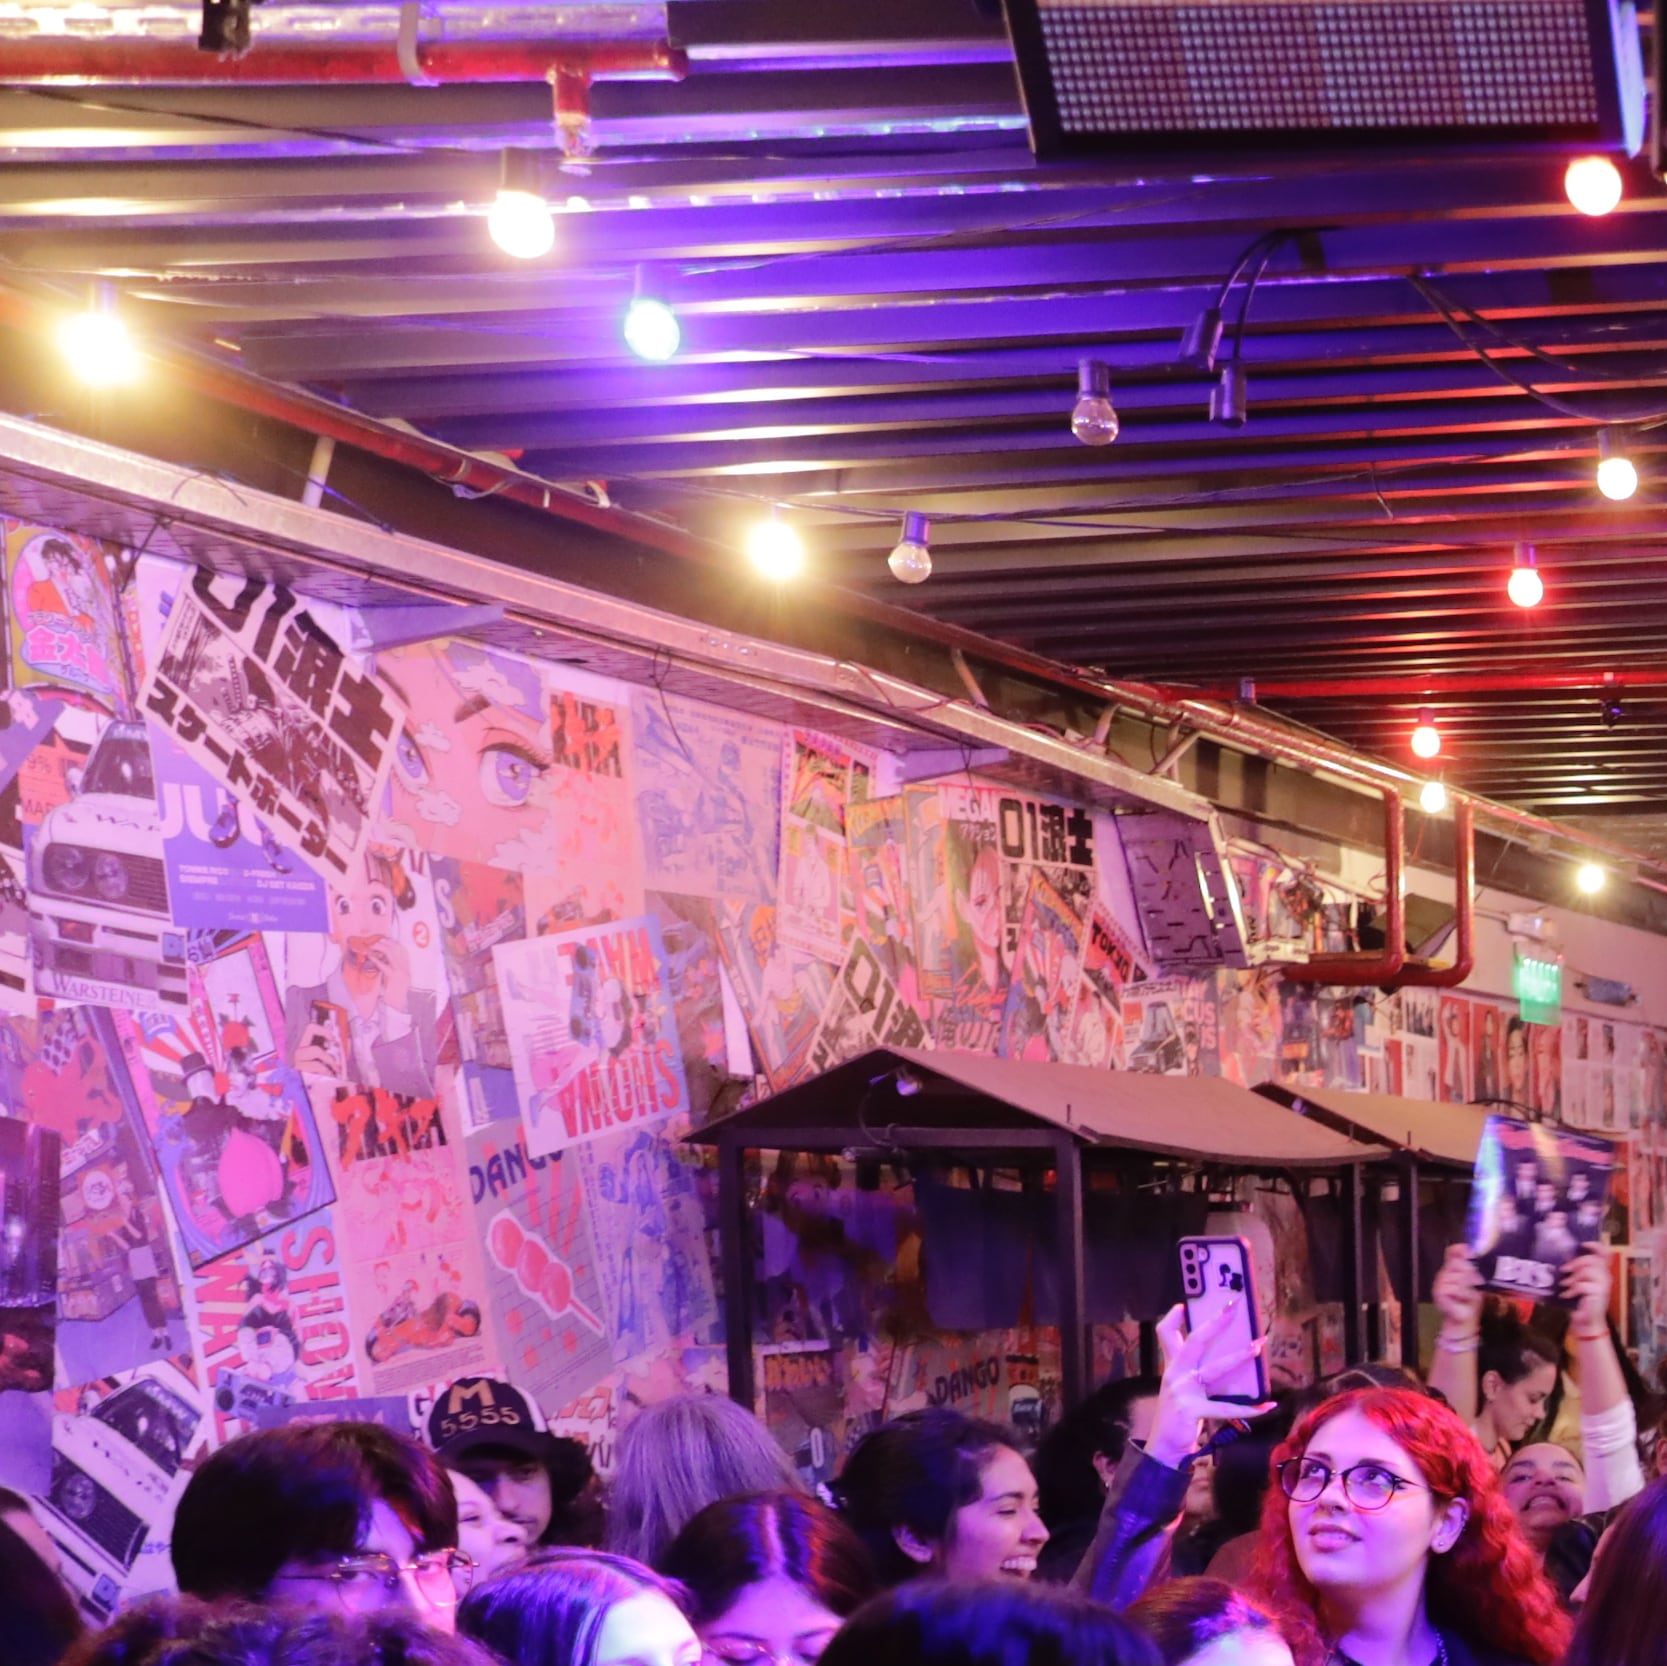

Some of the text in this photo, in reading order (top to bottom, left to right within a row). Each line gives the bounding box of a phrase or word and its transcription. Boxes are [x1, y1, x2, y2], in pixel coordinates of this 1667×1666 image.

[469, 1143, 564, 1204] DANG
[448, 1379, 495, 1414] M
[934, 1356, 999, 1404] DANGO
[440, 1406, 521, 1436] 5555
